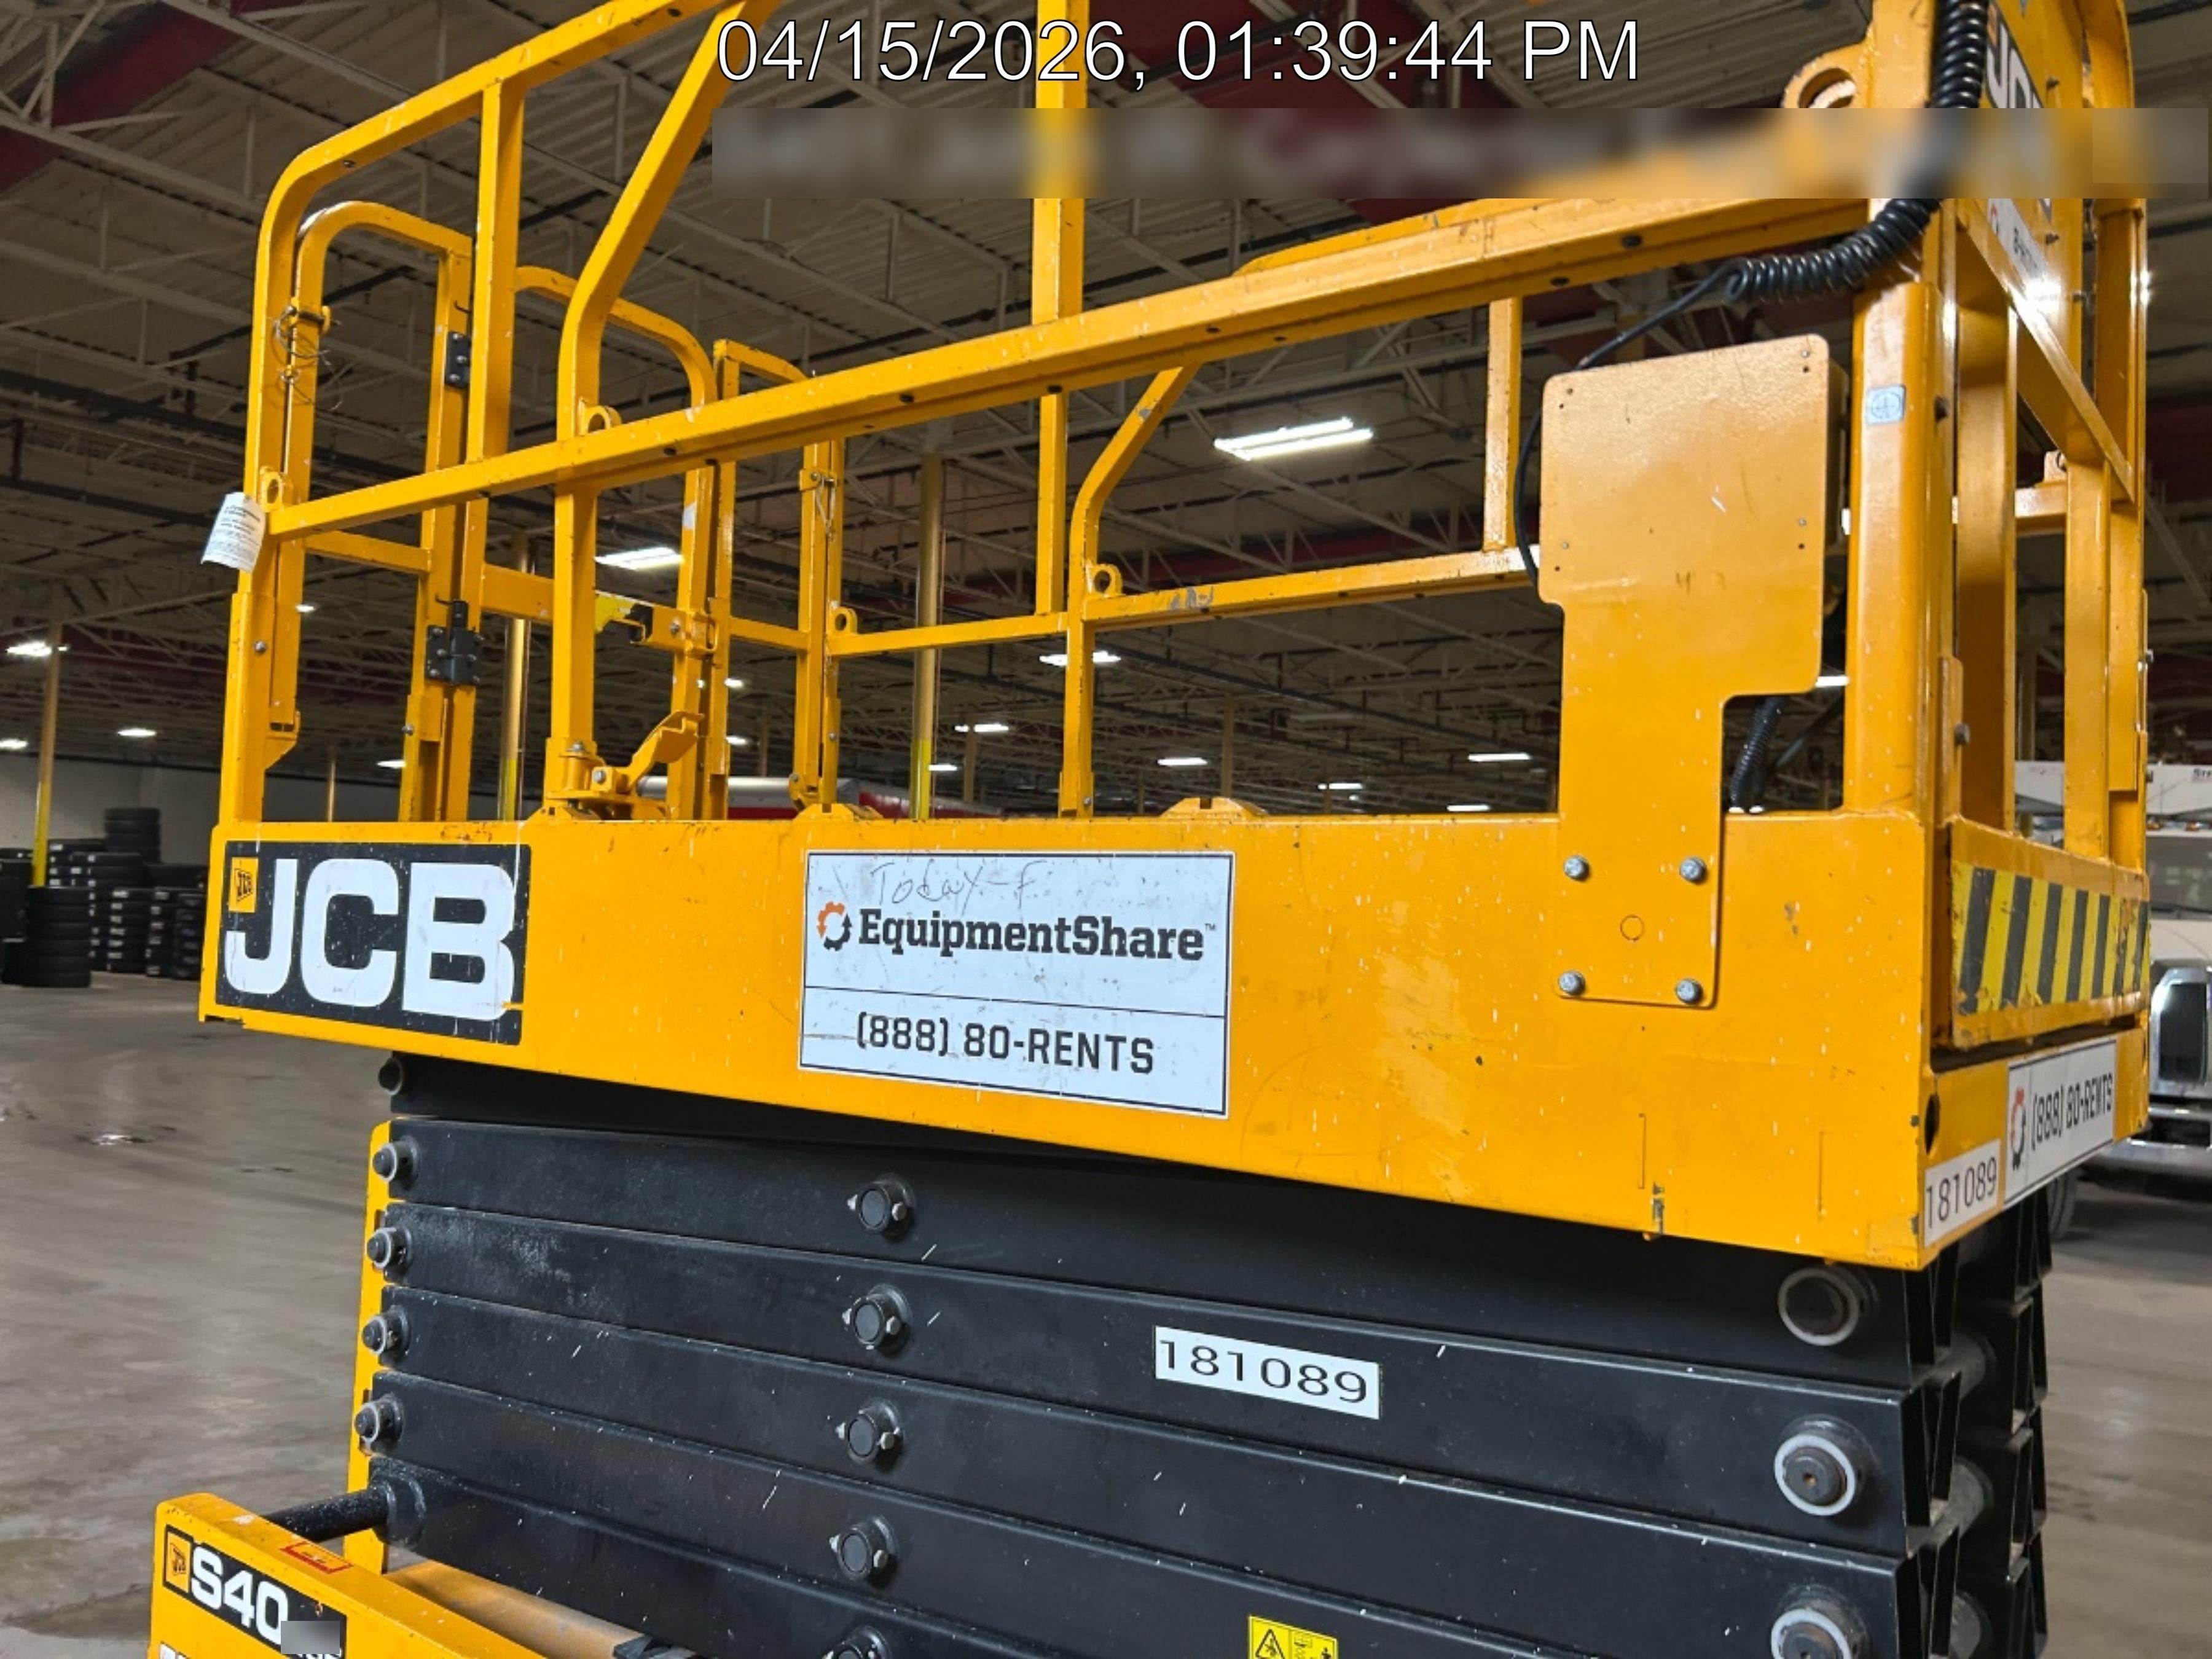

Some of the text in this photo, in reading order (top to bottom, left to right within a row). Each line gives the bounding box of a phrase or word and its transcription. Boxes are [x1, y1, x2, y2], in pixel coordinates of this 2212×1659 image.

[225, 858, 516, 1022] JCB
[857, 1011, 1155, 1075] (888) 80-RENTS
[2031, 1084, 2064, 1151] (888)
[1926, 1156, 1998, 1230] 181089
[1159, 1339, 1367, 1403] 181089
[190, 1545, 289, 1645] S40
